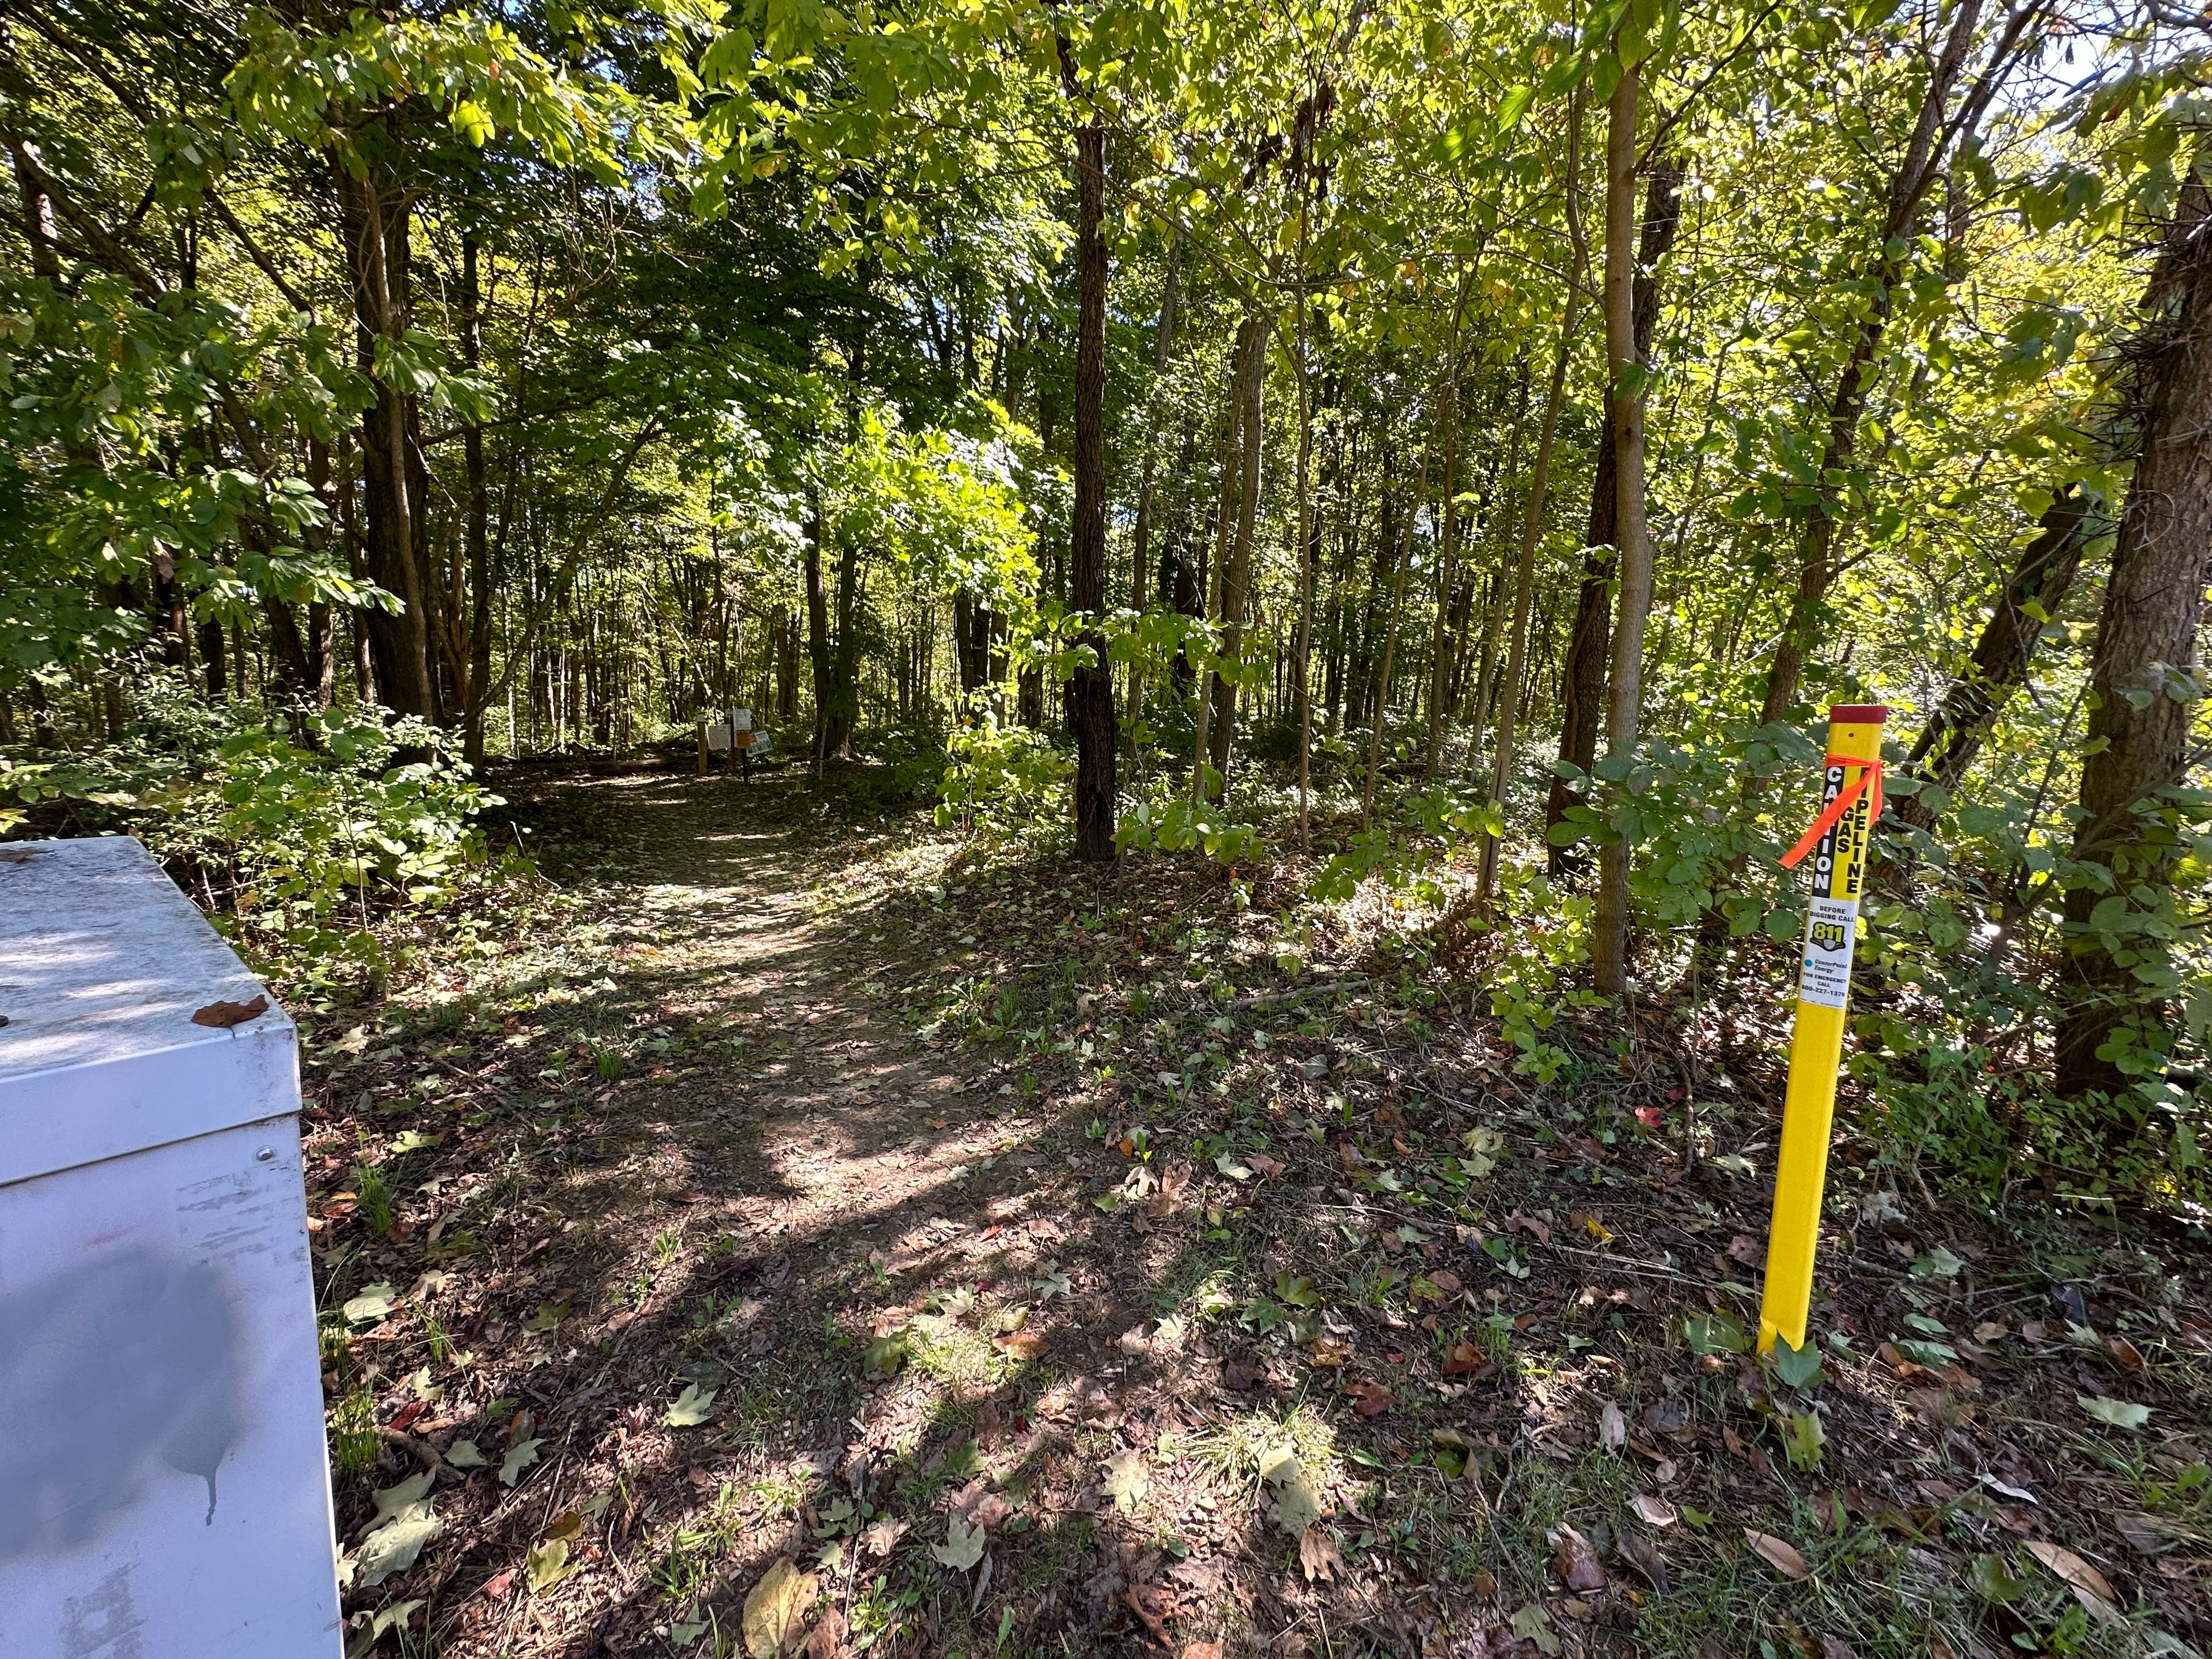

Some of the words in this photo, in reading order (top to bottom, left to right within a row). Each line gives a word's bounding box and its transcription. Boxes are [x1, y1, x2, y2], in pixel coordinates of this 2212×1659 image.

[1815, 767, 1842, 889] CAION
[1837, 806, 1854, 853] GAS
[1820, 906, 1846, 914] BEFORE
[1810, 911, 1836, 920] DIGGING
[1813, 923, 1843, 942] 811
[1815, 959, 1847, 968] CenterPoint
[1815, 965, 1834, 974] Energy
[1815, 974, 1846, 983] EMERGENCY
